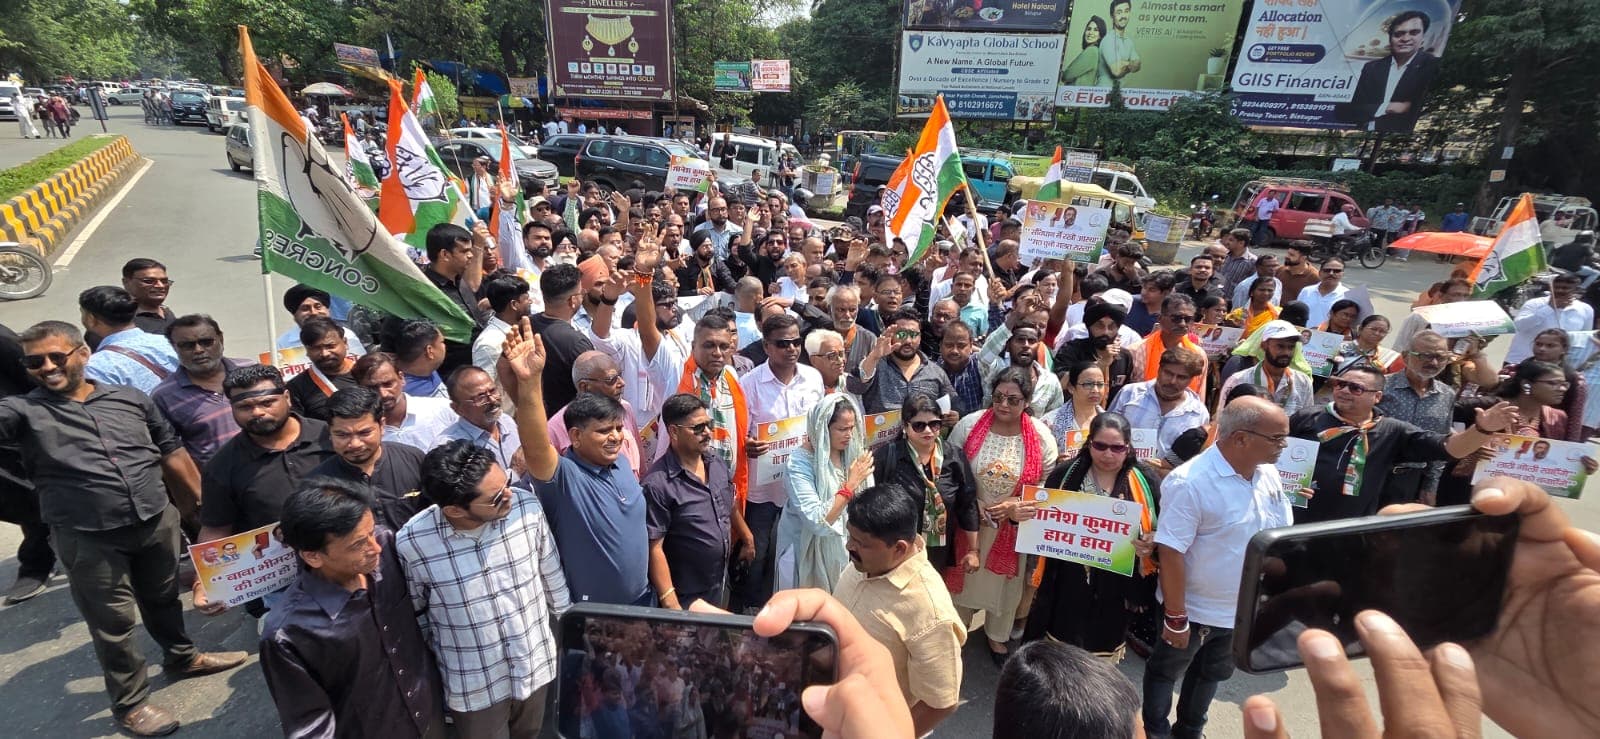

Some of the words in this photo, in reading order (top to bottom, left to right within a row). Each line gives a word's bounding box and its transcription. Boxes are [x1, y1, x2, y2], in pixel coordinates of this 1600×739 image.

[1141, 1, 1178, 11] Almost
[1194, 3, 1226, 12] smart
[1152, 15, 1176, 24] your
[1178, 15, 1208, 23] mom.
[1258, 10, 1322, 22] Allocation
[983, 37, 1019, 48] Global
[1022, 38, 1059, 49] School
[984, 58, 1008, 66] Global
[1238, 73, 1273, 87] GIIS
[1275, 74, 1353, 89] Financial
[958, 101, 1004, 109] 8102916675
[1076, 92, 1179, 107] Elekrokraf
[1032, 506, 1079, 526] ानेश
[1082, 514, 1132, 536] कुमार
[1043, 528, 1077, 545] हाय
[1080, 535, 1115, 553] हाय
[226, 566, 256, 581] बाबा
[233, 579, 253, 592] की
[254, 571, 276, 584] जय
